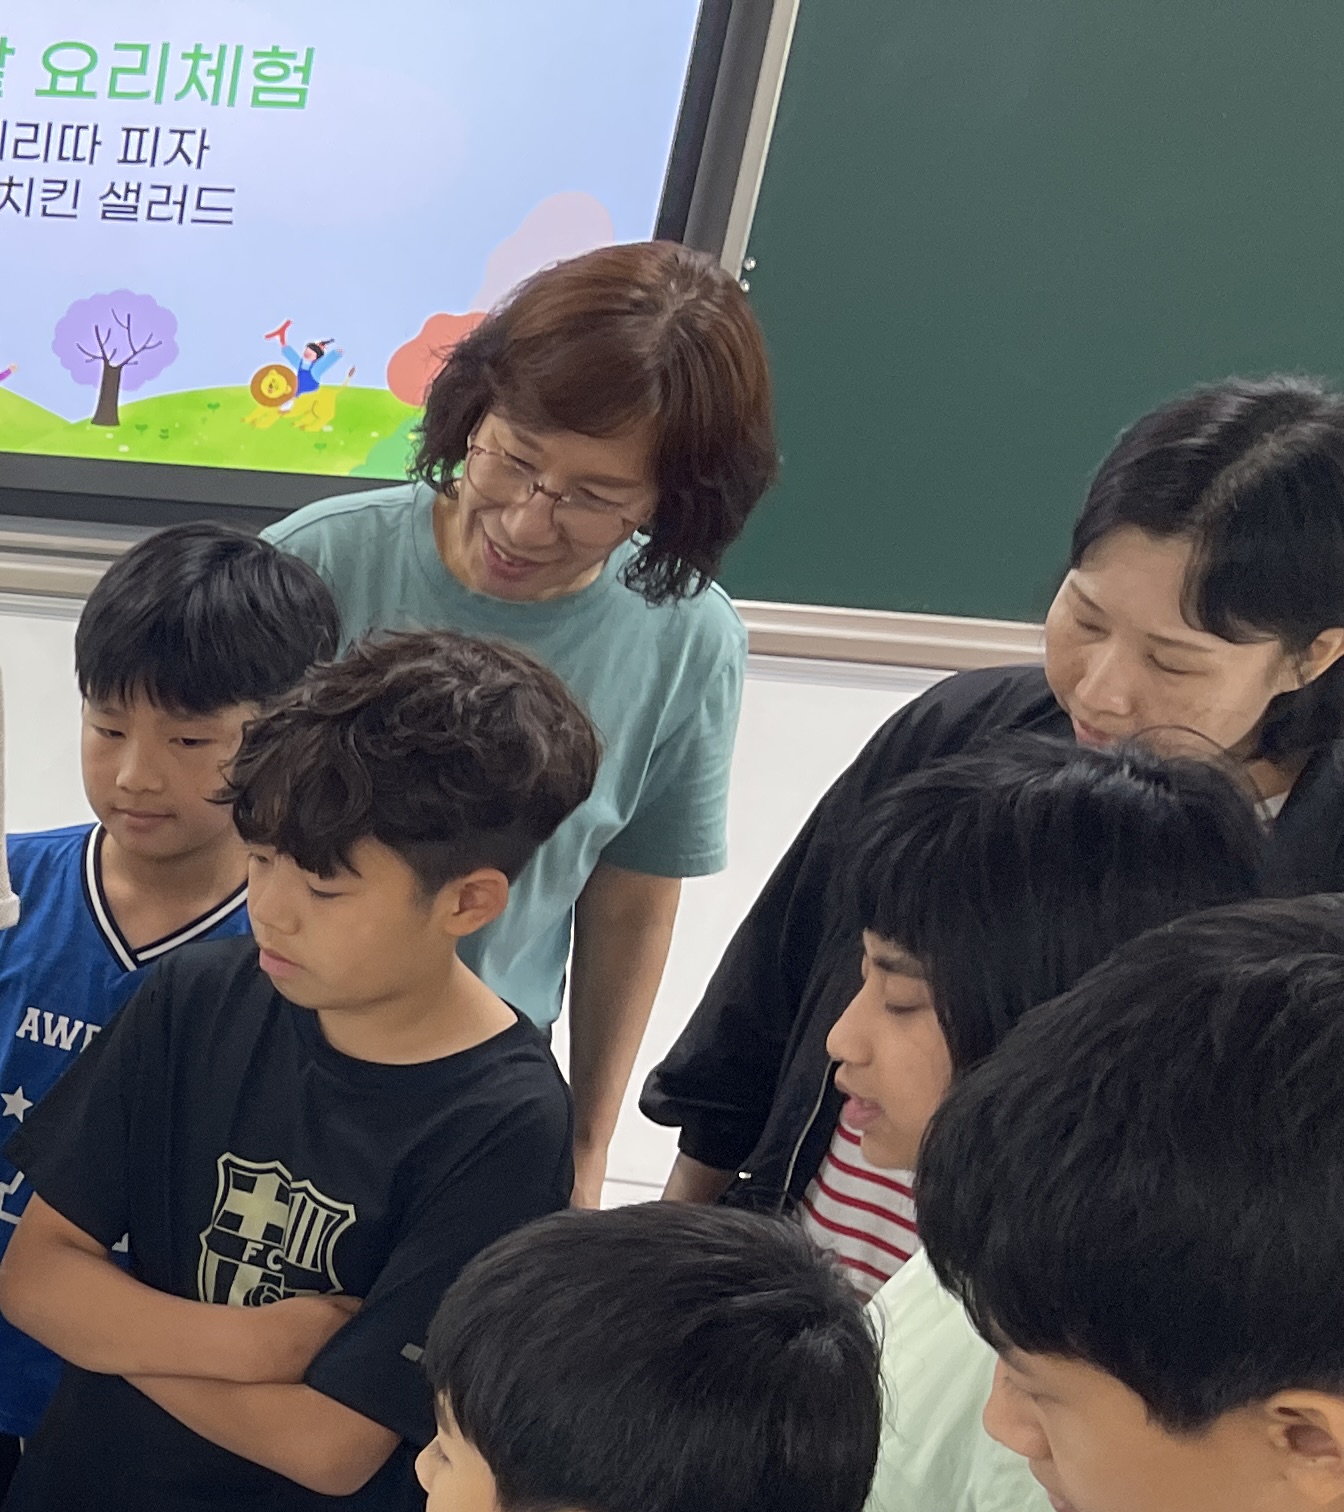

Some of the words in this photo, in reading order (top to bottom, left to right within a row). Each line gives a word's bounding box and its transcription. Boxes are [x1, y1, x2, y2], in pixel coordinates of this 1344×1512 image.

[34, 41, 315, 109] 요리체험
[116, 126, 211, 170] 피자
[98, 180, 235, 225] 샐러드
